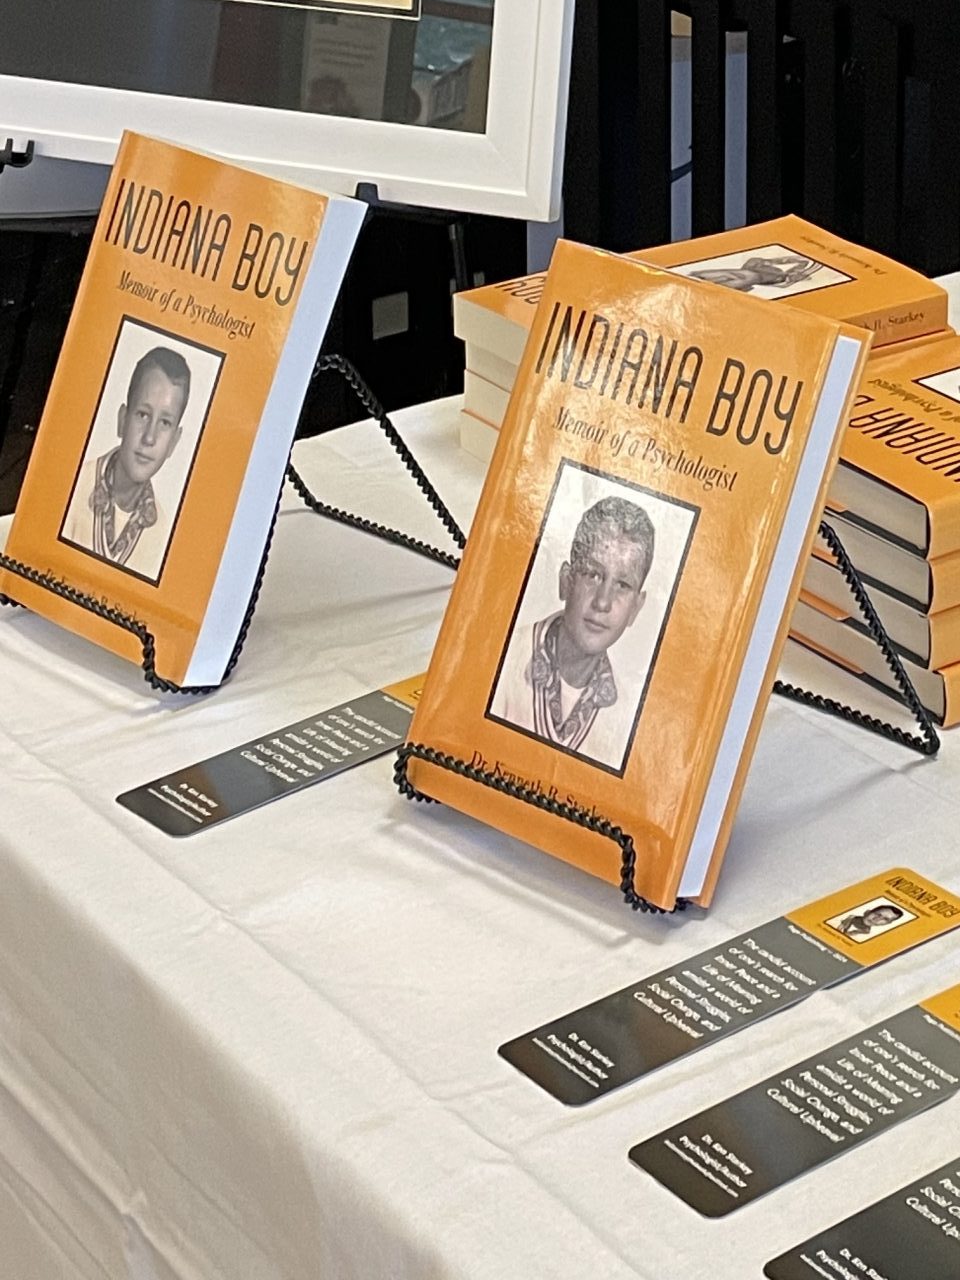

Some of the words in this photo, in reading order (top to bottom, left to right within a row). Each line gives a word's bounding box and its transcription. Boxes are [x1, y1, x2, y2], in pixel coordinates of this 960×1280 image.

[105, 179, 231, 280] INDIANA
[232, 223, 308, 306] BOY
[116, 269, 159, 302] Memoir
[159, 288, 176, 313] of
[172, 288, 183, 312] a
[182, 294, 256, 340] Psychologist
[536, 303, 702, 422] INDIANA
[706, 358, 803, 454] BOY
[550, 406, 609, 452] Memoir
[609, 424, 631, 457] of
[625, 432, 646, 460] a
[641, 433, 738, 491] Psychologist
[885, 876, 938, 905] INDIANA
[816, 1249, 860, 1280] Psycholog
